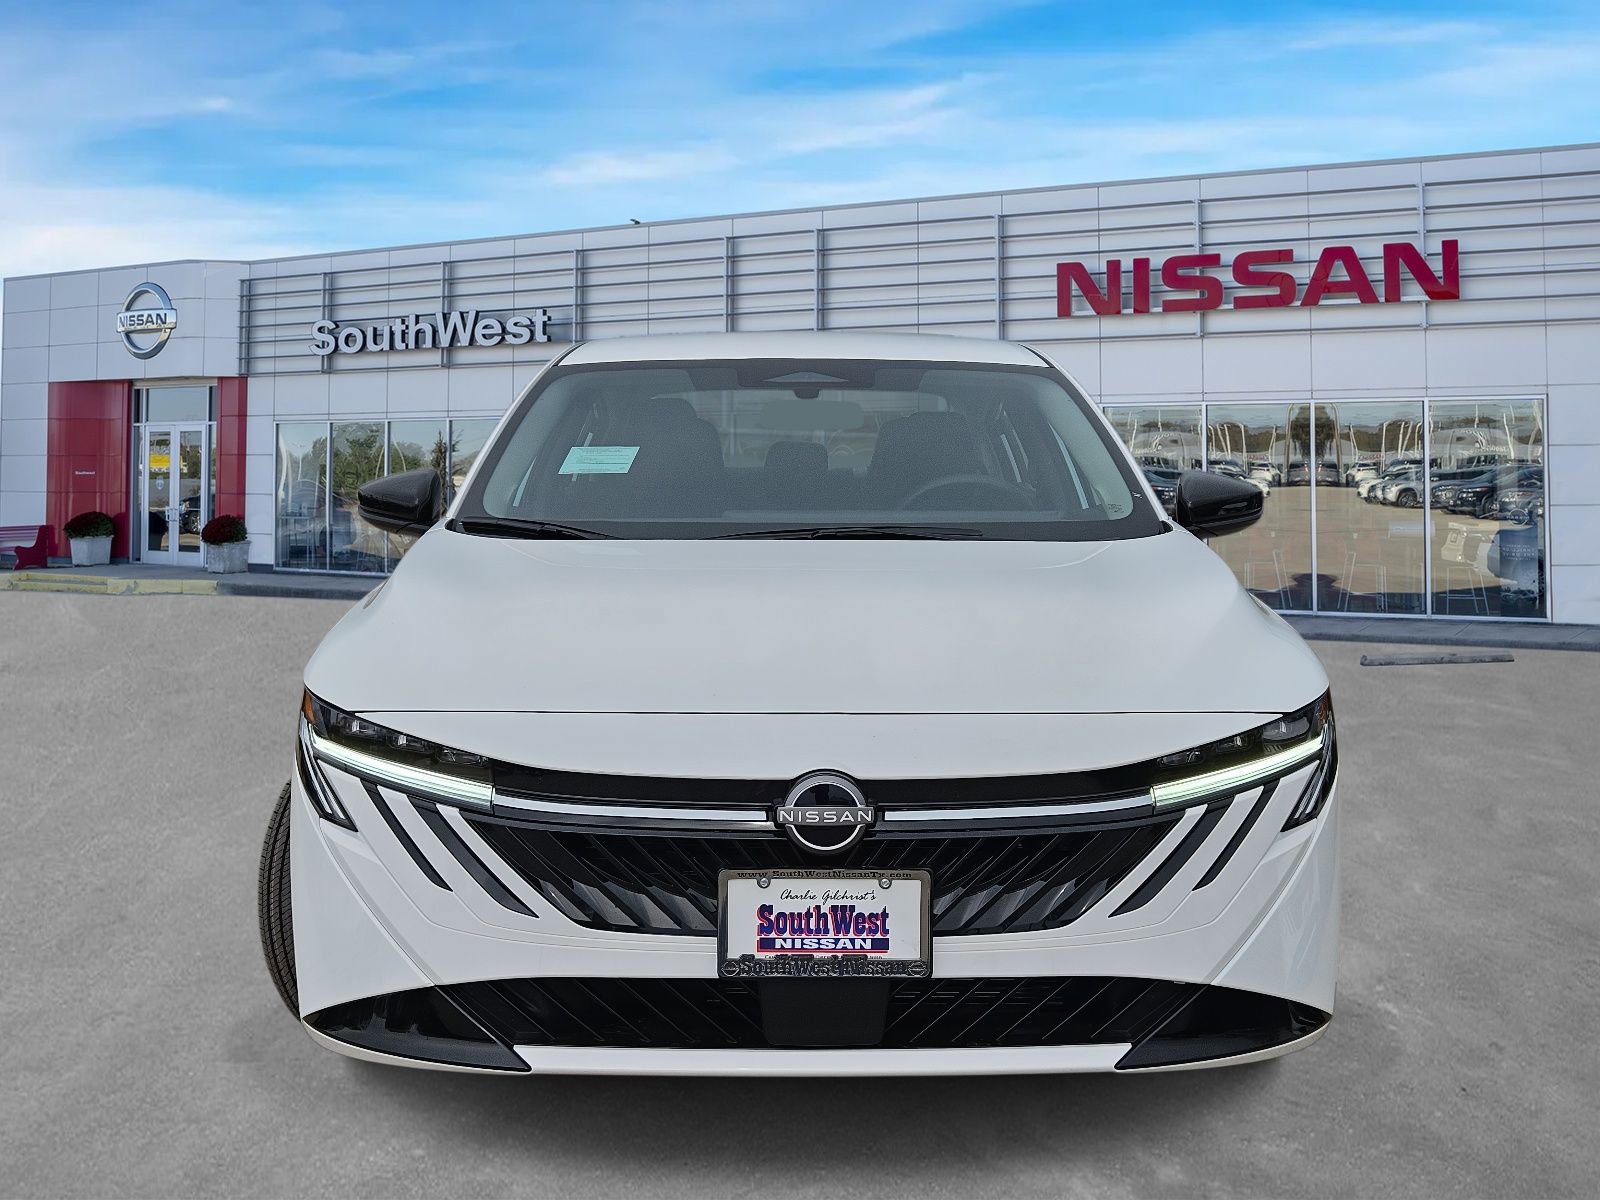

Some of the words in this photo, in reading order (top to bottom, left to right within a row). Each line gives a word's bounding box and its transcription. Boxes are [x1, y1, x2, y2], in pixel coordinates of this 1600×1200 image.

[1056, 239, 1460, 318] NISSAN
[118, 313, 168, 328] NISSAN
[308, 308, 552, 356] SouthWest
[780, 810, 872, 823] NISSAN
[780, 888, 818, 901] Charlie
[821, 888, 877, 905] Gilchrist's
[757, 903, 890, 937] SouthWest
[774, 938, 872, 950] NISSAN
